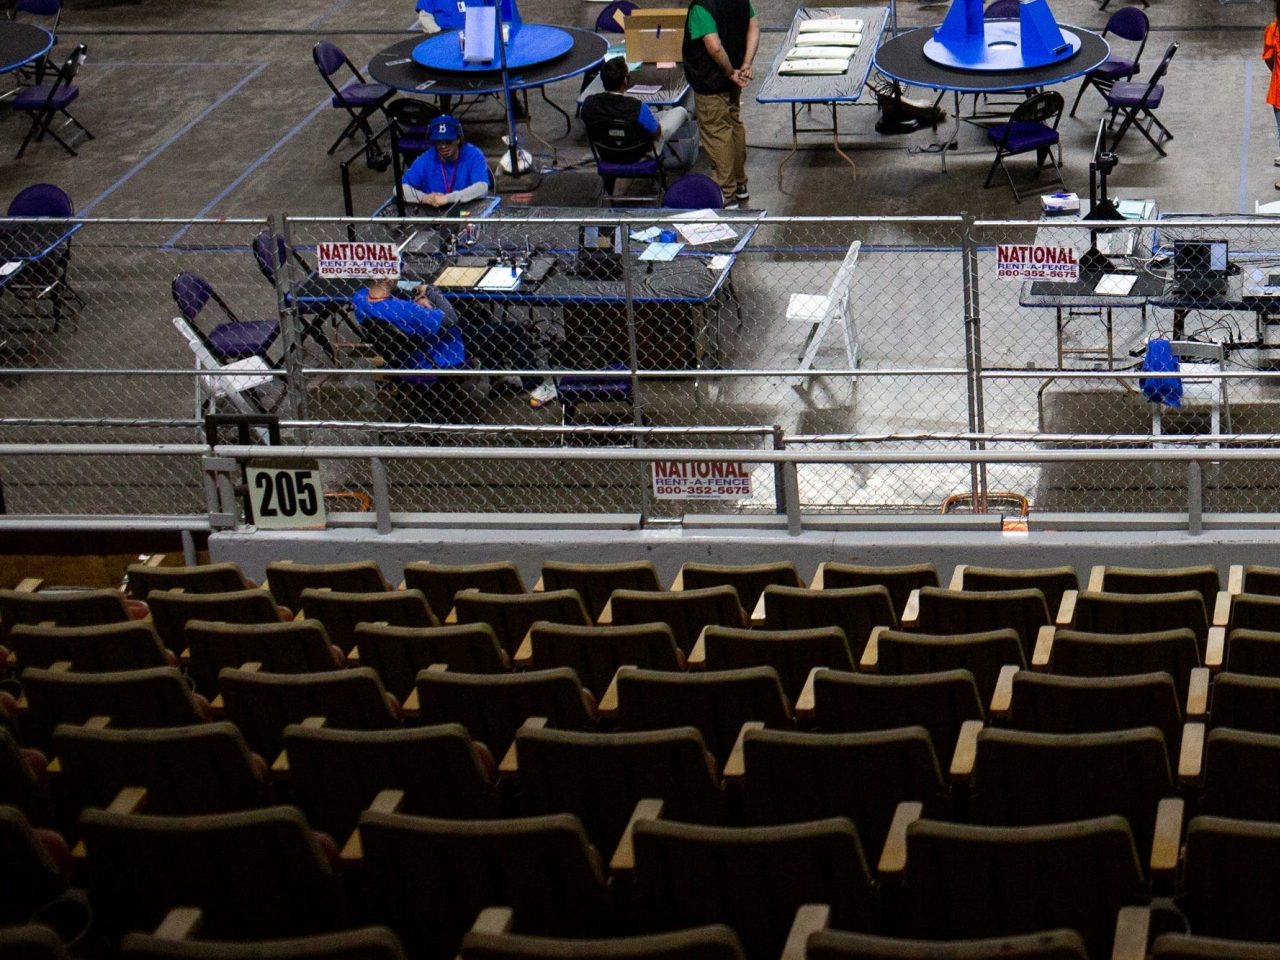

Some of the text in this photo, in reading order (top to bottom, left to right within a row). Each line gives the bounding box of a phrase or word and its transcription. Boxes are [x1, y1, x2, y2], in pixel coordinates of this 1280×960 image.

[439, 124, 447, 133] B
[319, 243, 398, 261] NATIONAL
[998, 246, 1077, 264] NATIONAL
[320, 260, 398, 268] RENT-A-FENCE
[997, 263, 1077, 272] RENT-A-FENCE
[321, 267, 398, 275] 800-352-5675
[998, 270, 1077, 278] 800-352-5675
[654, 460, 749, 478] NATIONAL
[655, 478, 750, 486] RENT-A-FENCE
[255, 471, 318, 517] 205
[656, 486, 750, 495] 800-352-5675
